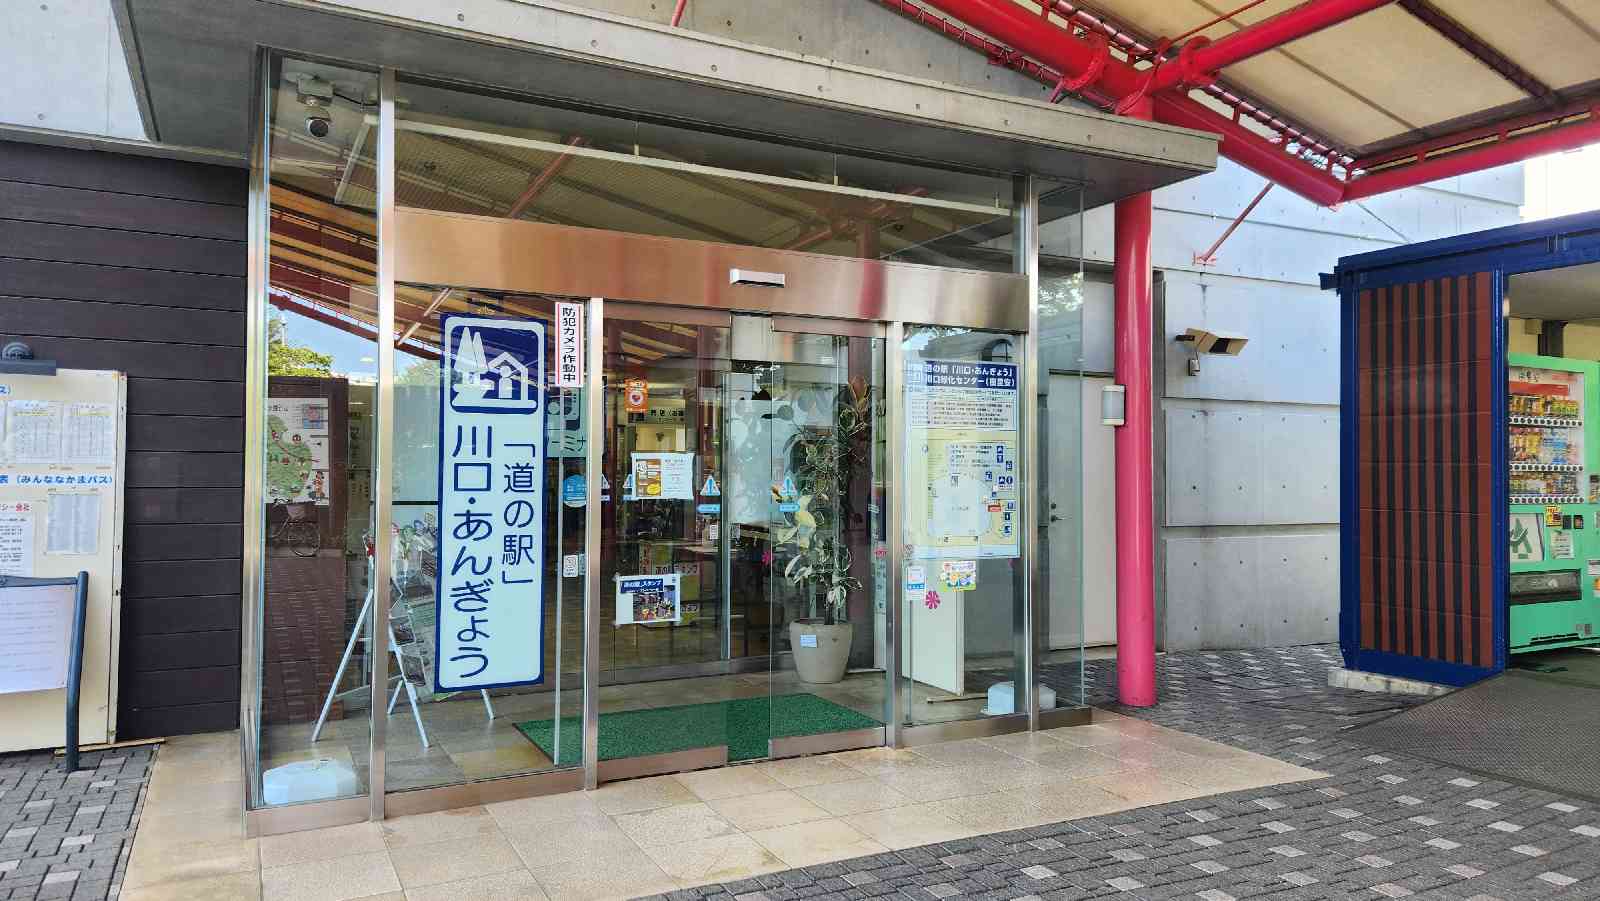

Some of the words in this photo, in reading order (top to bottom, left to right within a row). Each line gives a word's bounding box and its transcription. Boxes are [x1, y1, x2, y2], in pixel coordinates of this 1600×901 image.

[562, 307, 577, 382] 防犯カメラ作動中
[449, 425, 494, 678] 川口・あんぎょう
[501, 443, 536, 584] 「道の駅」
